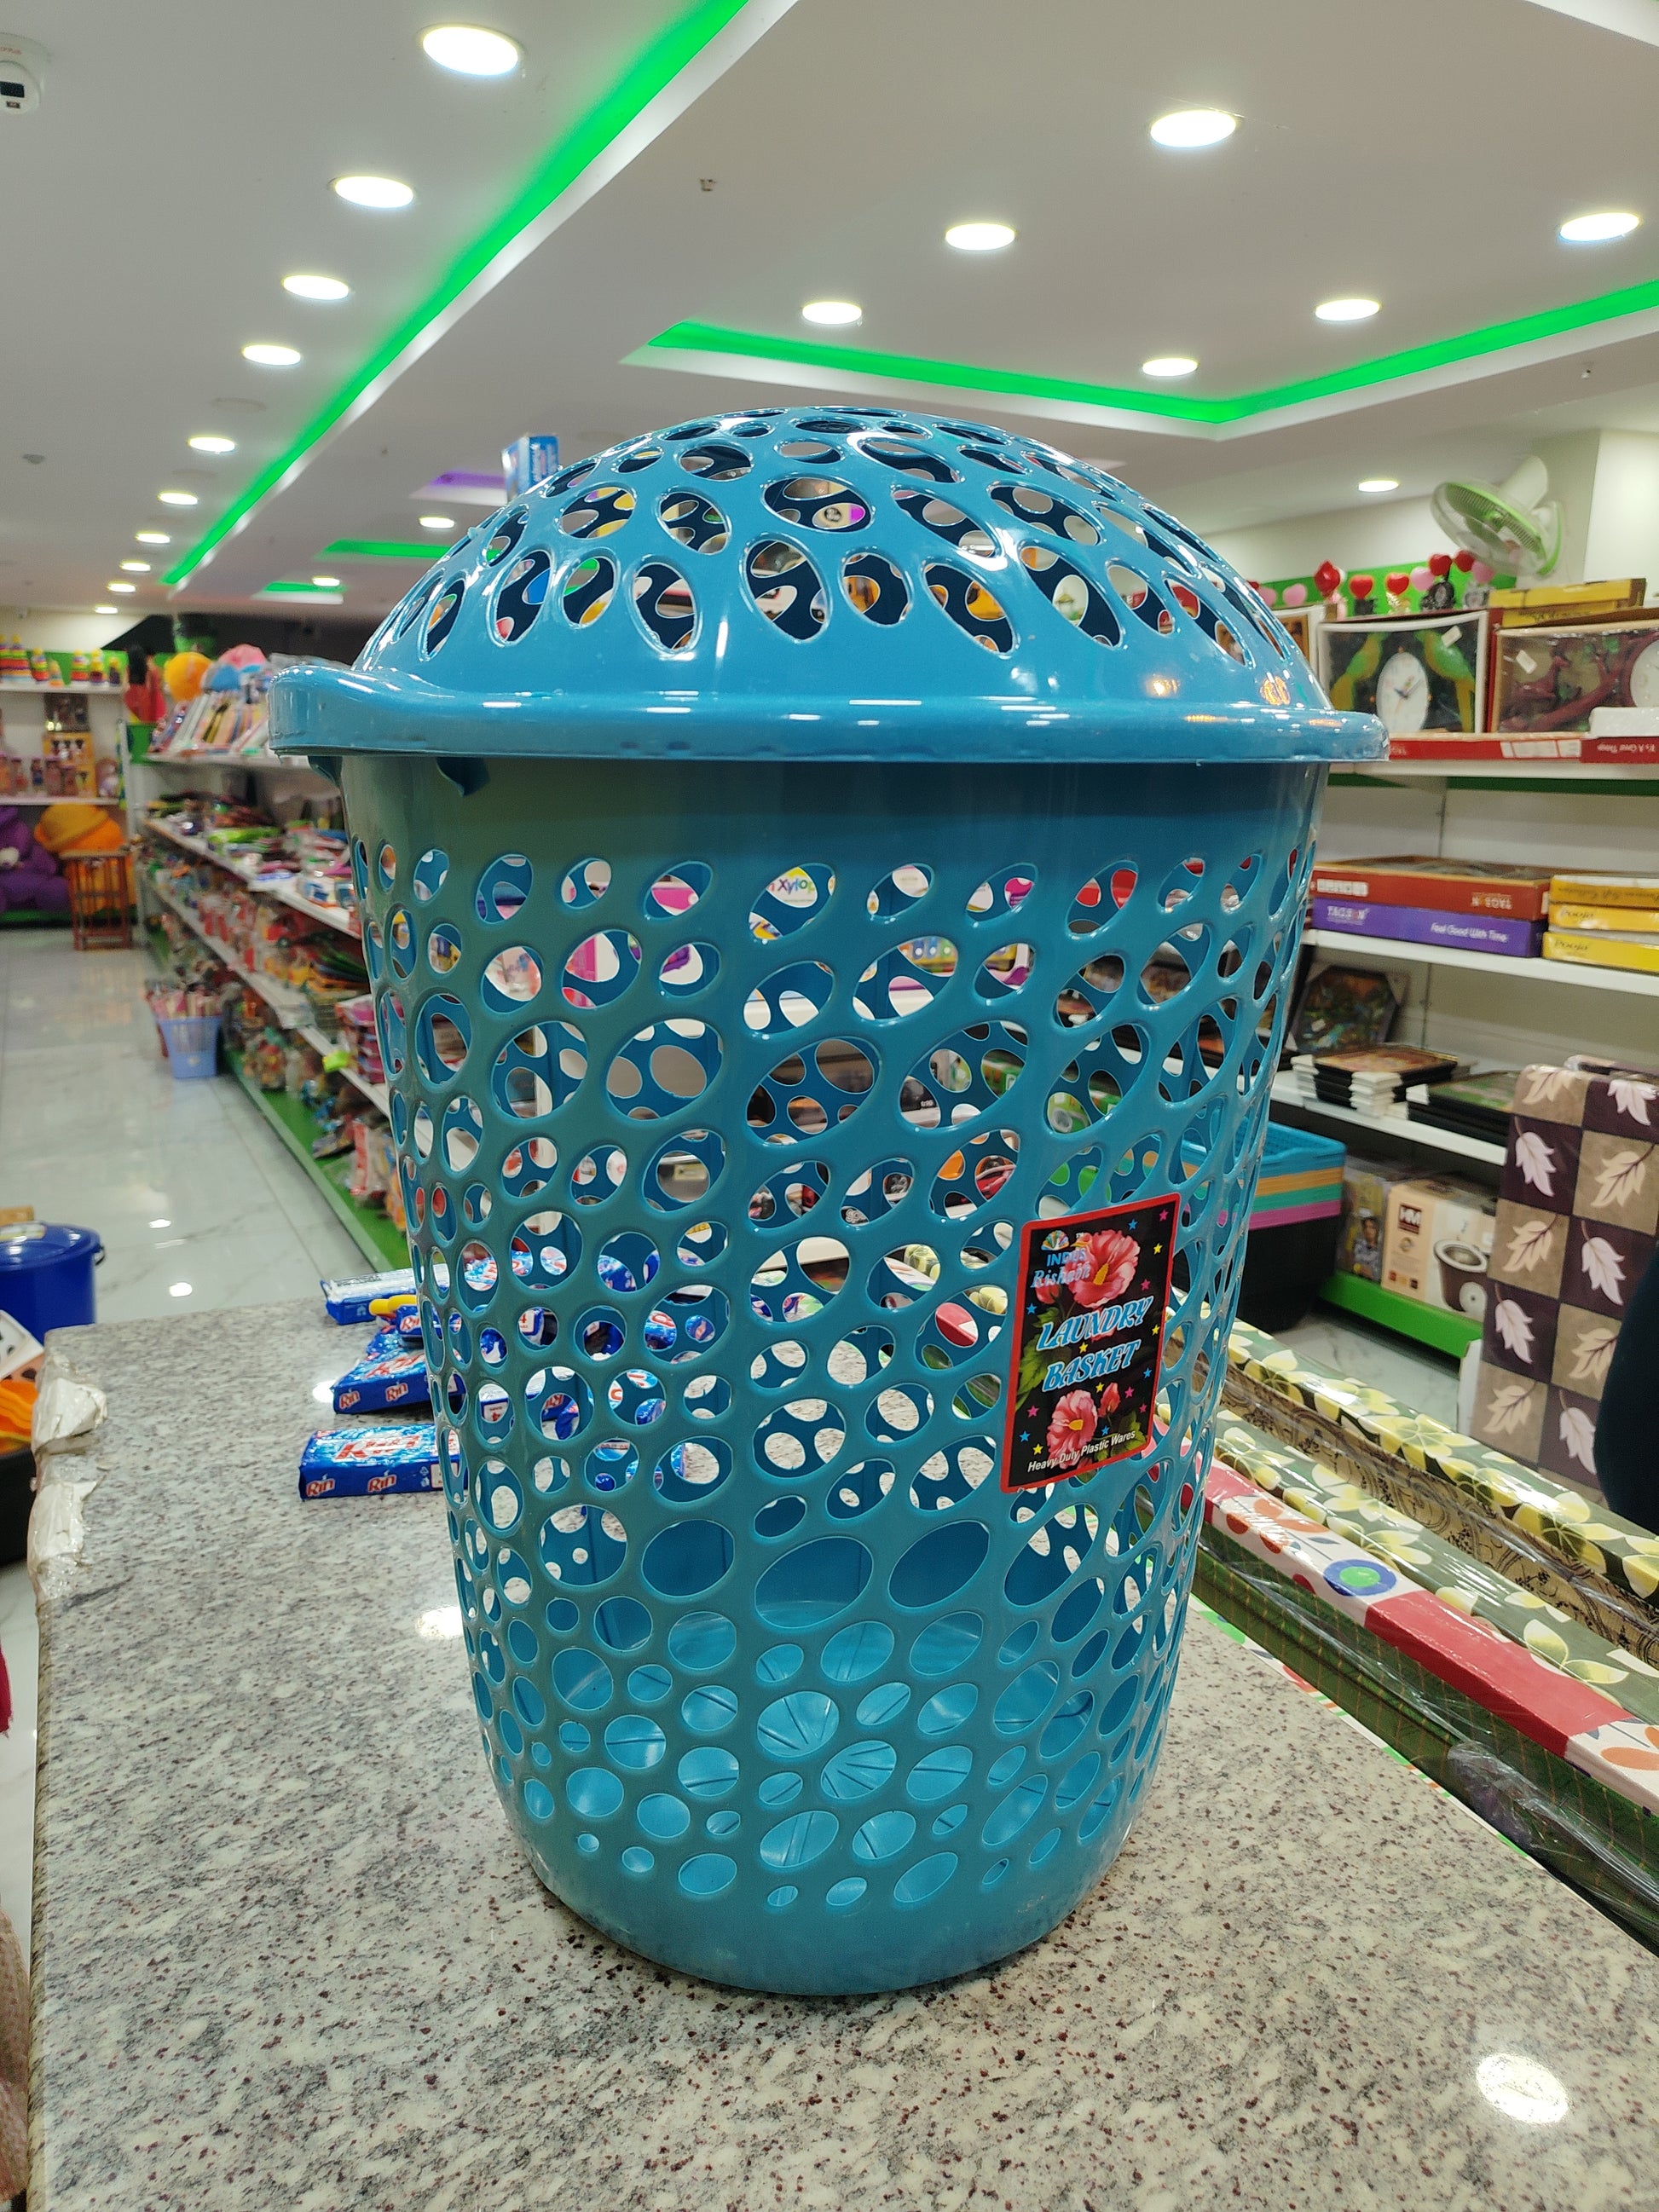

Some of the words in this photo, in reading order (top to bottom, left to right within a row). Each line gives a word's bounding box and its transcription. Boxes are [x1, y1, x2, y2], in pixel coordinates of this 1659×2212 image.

[1447, 924, 1469, 938] Good
[1046, 1248, 1086, 1267] INDUS
[1036, 1296, 1154, 1351] LAUNDRY
[1042, 1340, 1142, 1393] BASKET
[339, 1391, 361, 1409] Rin
[385, 1383, 408, 1402] Rin
[1027, 1457, 1057, 1472] Heavy
[1059, 1449, 1080, 1464] Duty
[1081, 1440, 1109, 1456] Plastic
[1110, 1430, 1136, 1446] Wares
[306, 1479, 335, 1497] Rin
[368, 1475, 397, 1493] Rin
